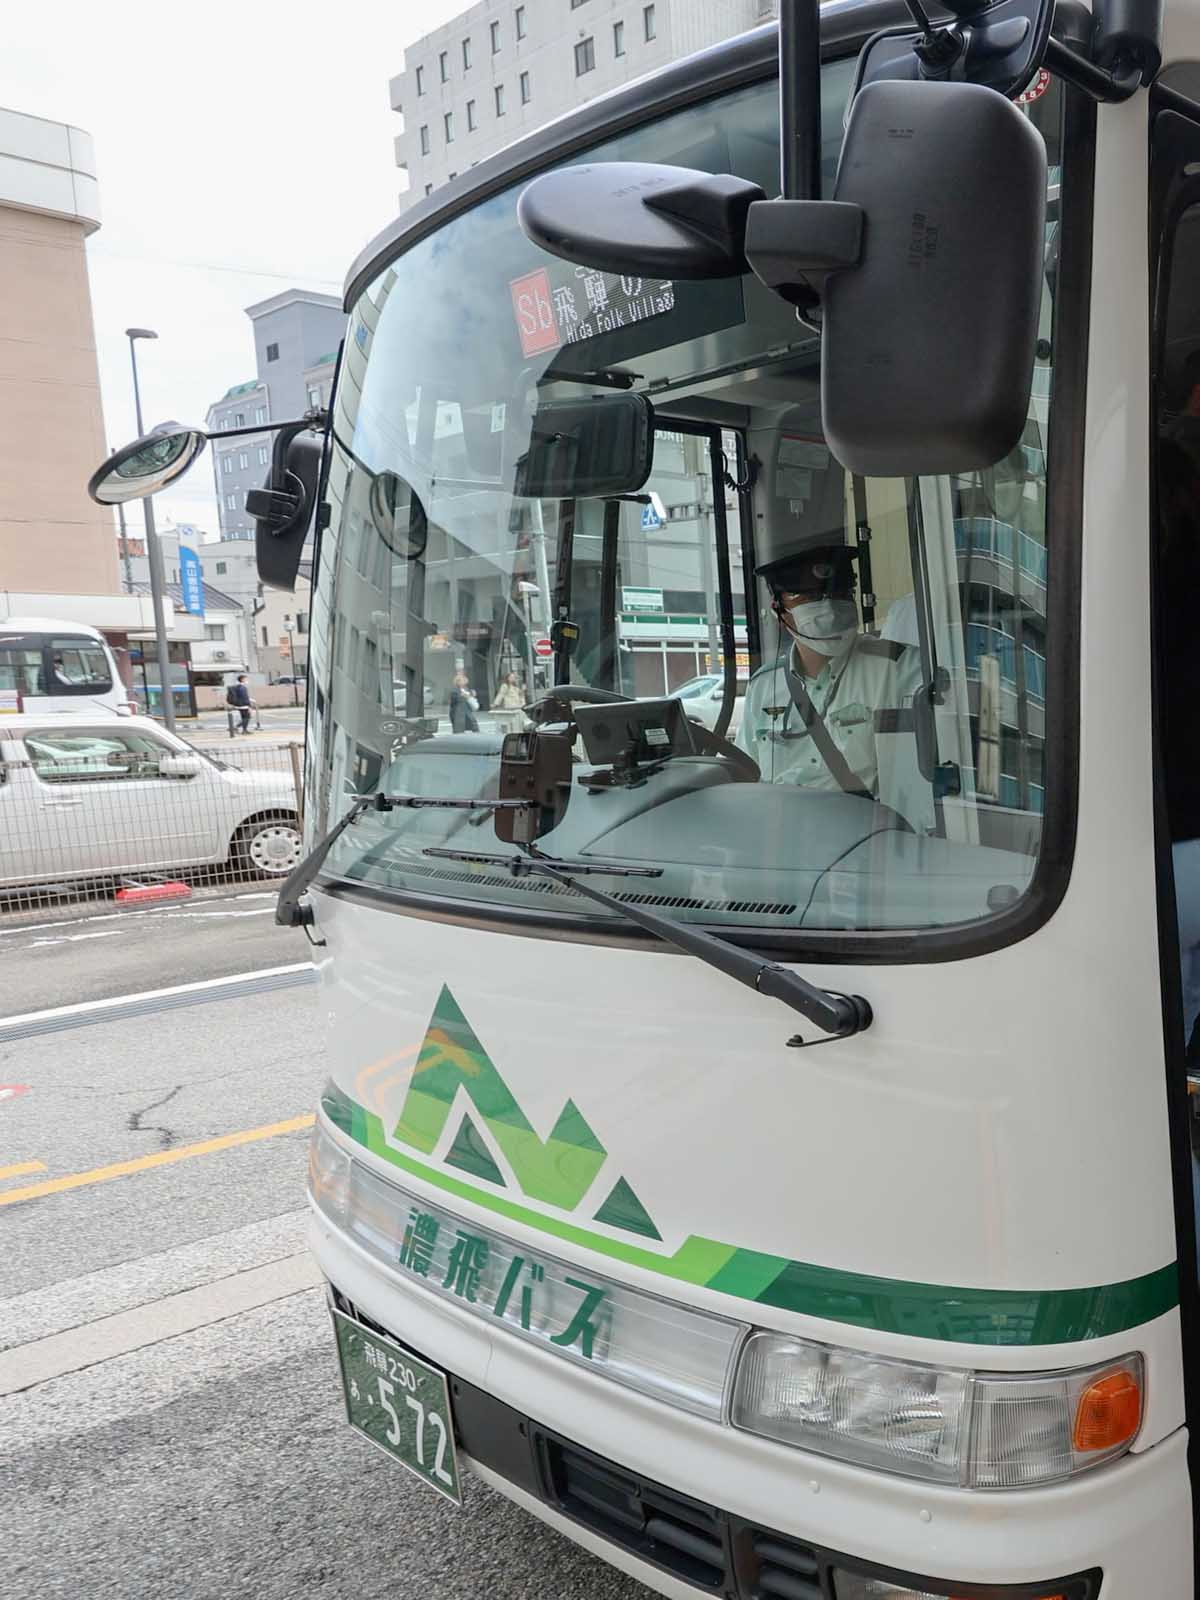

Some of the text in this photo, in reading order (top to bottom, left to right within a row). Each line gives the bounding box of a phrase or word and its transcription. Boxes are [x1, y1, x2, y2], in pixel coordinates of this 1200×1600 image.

[518, 289, 552, 335] Sb
[566, 322, 593, 345] Hida
[596, 308, 625, 333] Folk
[400, 1206, 605, 1360] 濃飛バス
